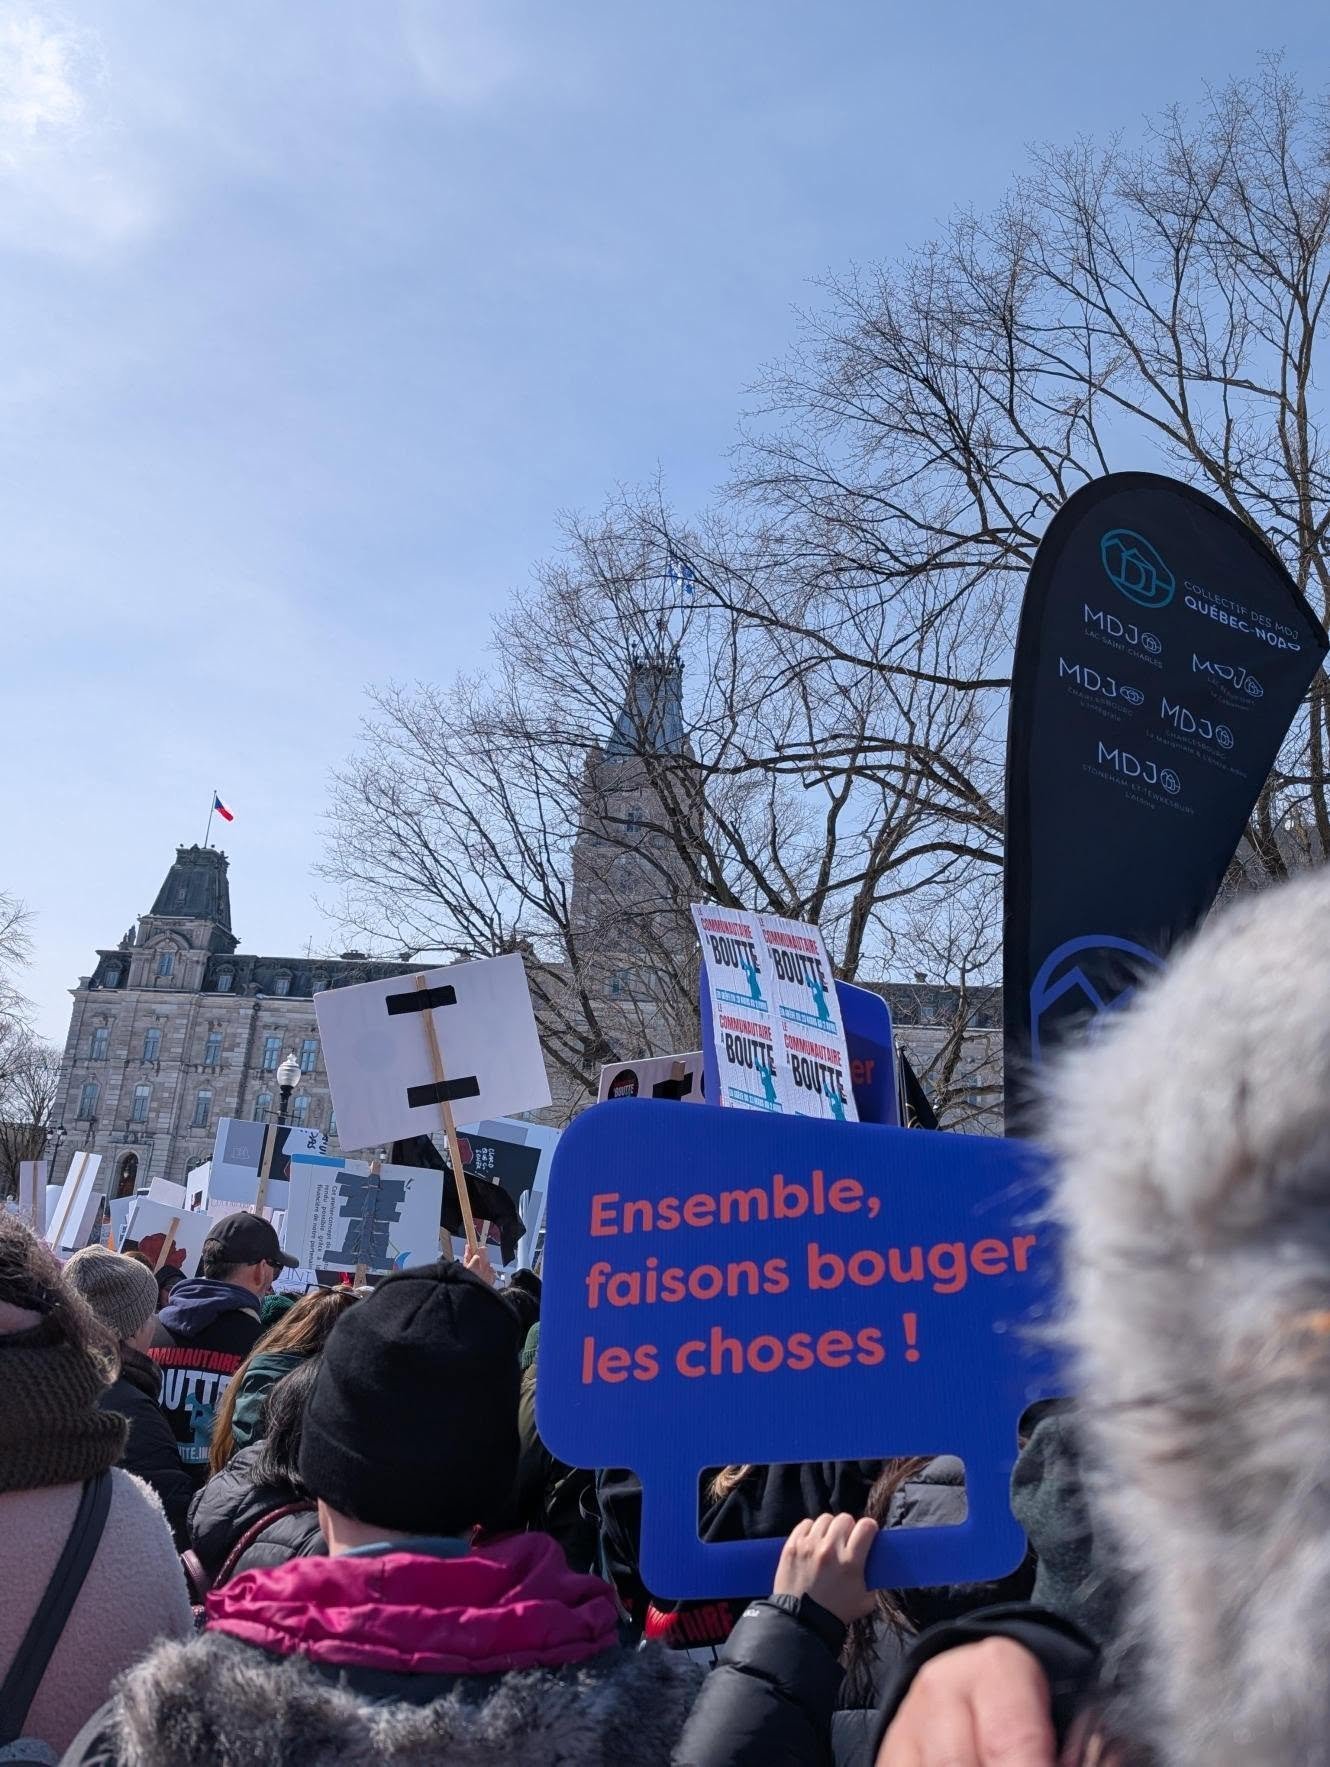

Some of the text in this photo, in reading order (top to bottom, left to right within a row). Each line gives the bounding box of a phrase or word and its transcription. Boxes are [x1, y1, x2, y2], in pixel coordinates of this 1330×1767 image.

[1083, 603, 1138, 644] MDJ
[1183, 580, 1249, 615] COLLECTIF
[1250, 611, 1273, 628] DES
[1184, 595, 1302, 652] QUÉBEC-NORD
[1059, 657, 1117, 698] MDJ
[1193, 653, 1247, 689] MDJ
[1161, 697, 1213, 739] MDJ
[1098, 741, 1157, 783] MDJ
[701, 918, 754, 939] COMMUNAUTAIRE
[762, 929, 820, 956] COMMUNAUTAIRE
[711, 935, 761, 974] BOUTTE
[772, 948, 829, 993] BOUTTE
[718, 1014, 773, 1042] COMMUNAUTAIRE
[725, 1033, 777, 1077] BOUTTE
[783, 1034, 842, 1067] COMMUNAUTAIRE
[792, 1054, 848, 1104] BOUTTE
[588, 1169, 883, 1238] Ensemble,
[585, 1234, 1038, 1310] faisons bouger
[581, 1312, 922, 1386] les choses !
